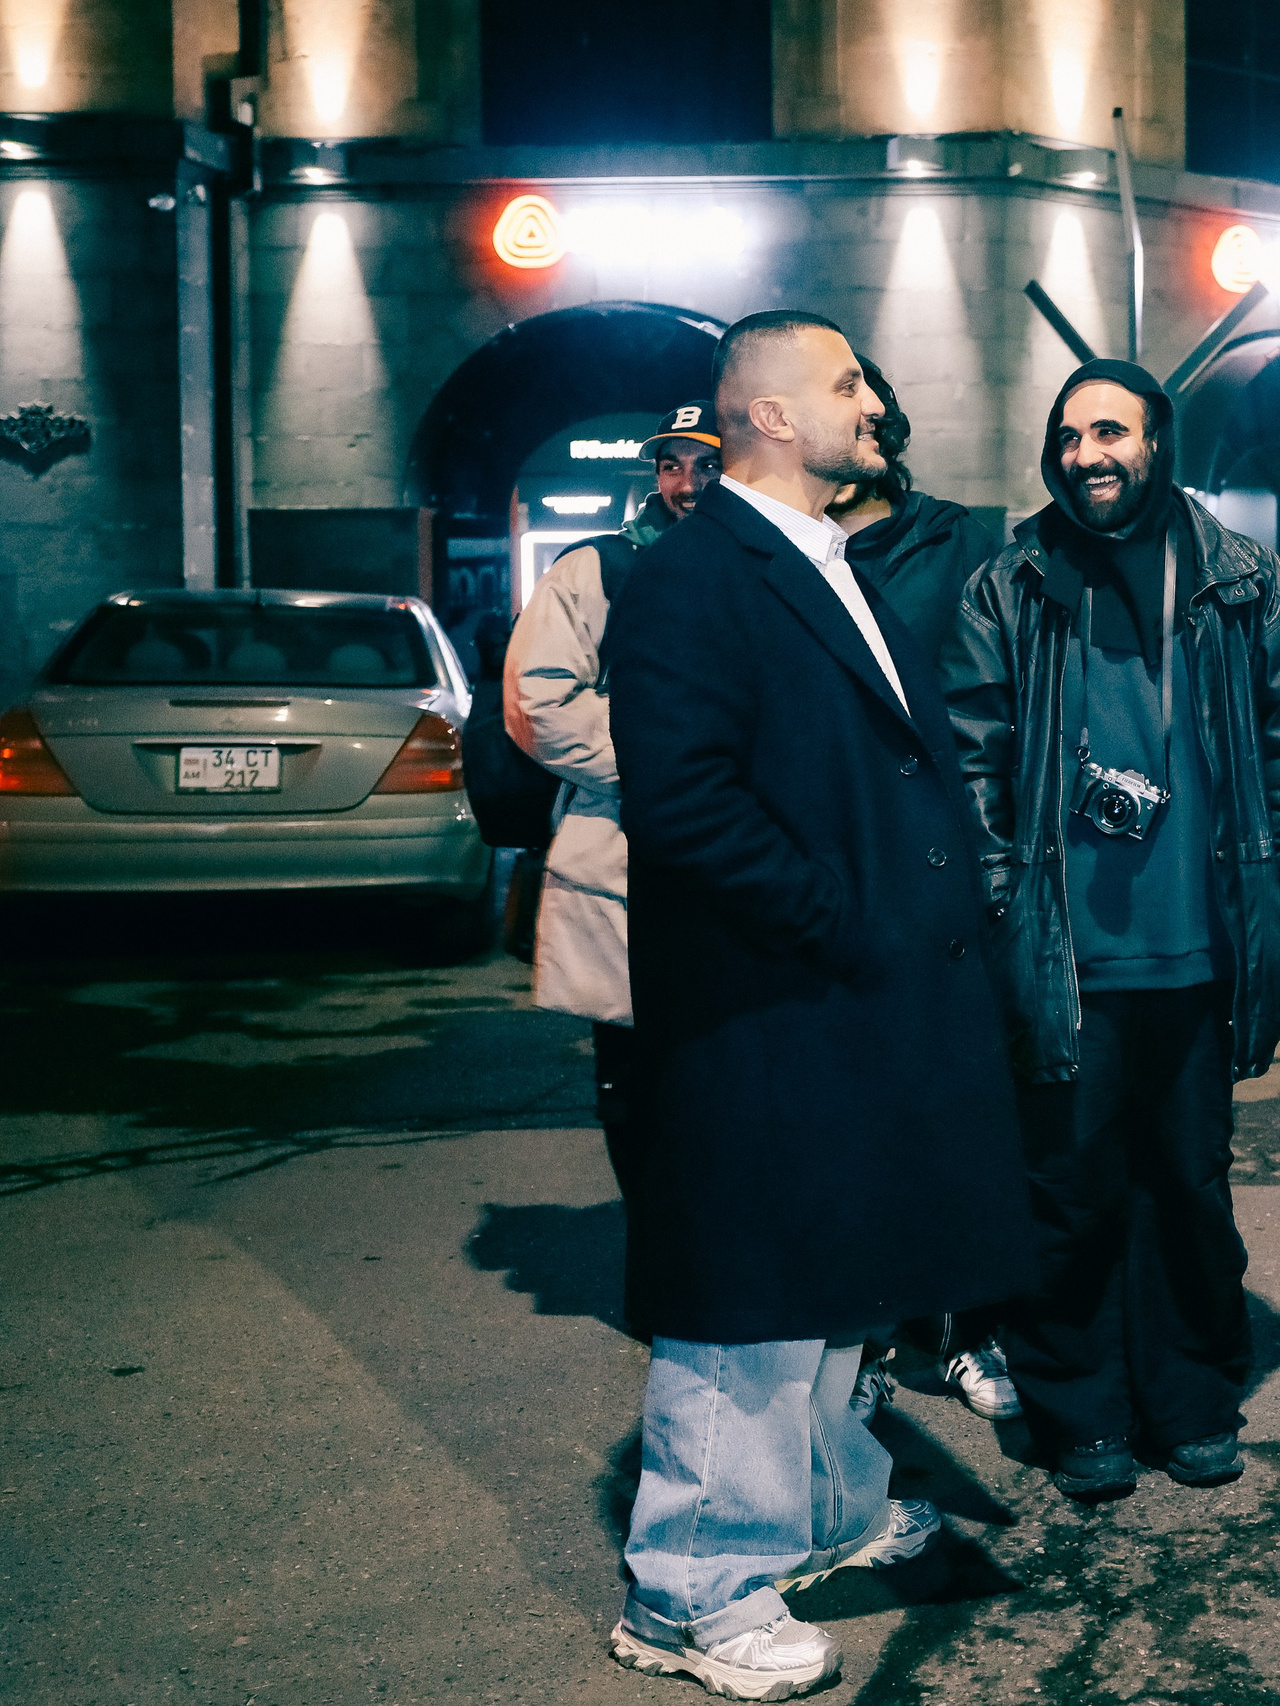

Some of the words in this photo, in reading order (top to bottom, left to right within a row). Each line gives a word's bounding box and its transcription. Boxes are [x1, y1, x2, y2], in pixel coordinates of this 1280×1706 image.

[671, 406, 703, 430] B
[211, 749, 235, 768] 34
[245, 749, 273, 768] CT
[183, 770, 200, 779] AM
[223, 769, 259, 788] 217
